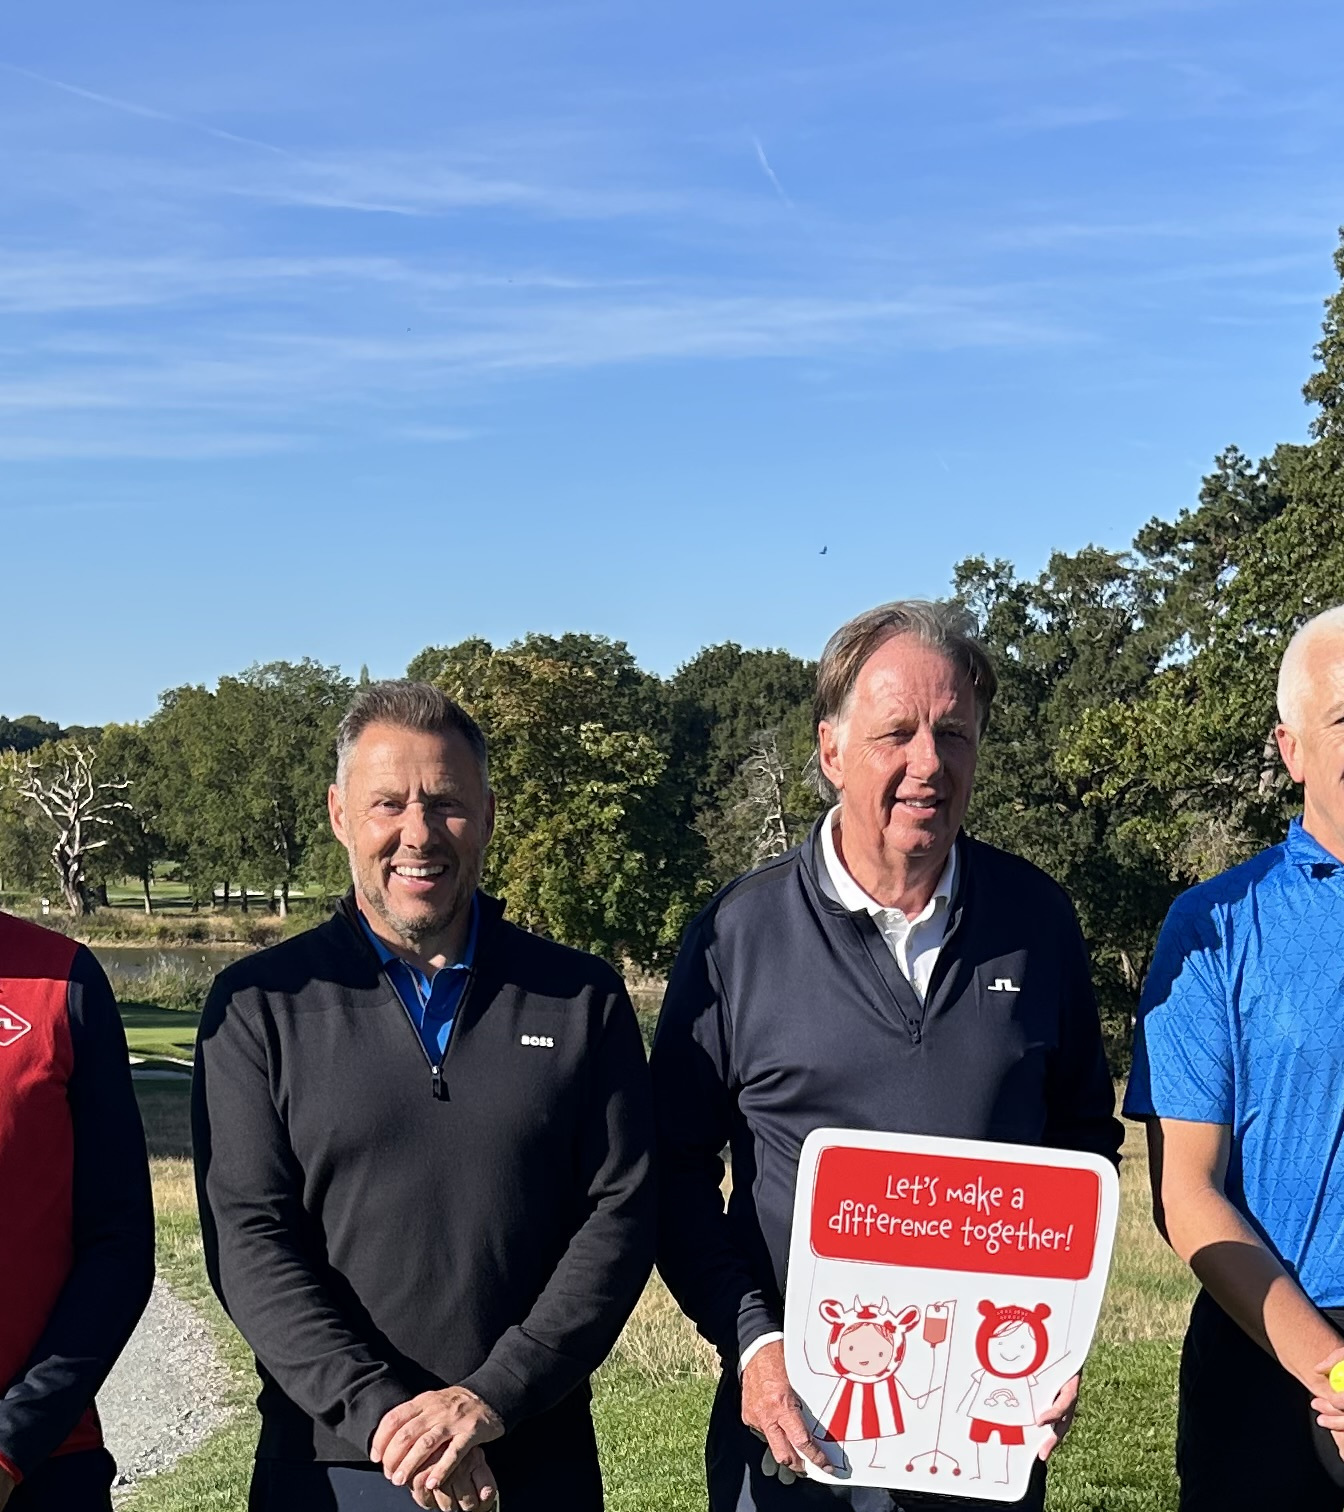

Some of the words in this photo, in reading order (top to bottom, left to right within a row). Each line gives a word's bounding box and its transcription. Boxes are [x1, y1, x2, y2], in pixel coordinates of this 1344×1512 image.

[521, 1035, 554, 1048] BOSS
[885, 1174, 940, 1206] Let's
[946, 1176, 1004, 1216] make
[1010, 1187, 1024, 1210] a
[828, 1199, 953, 1239] difference
[960, 1216, 1074, 1254] together!
